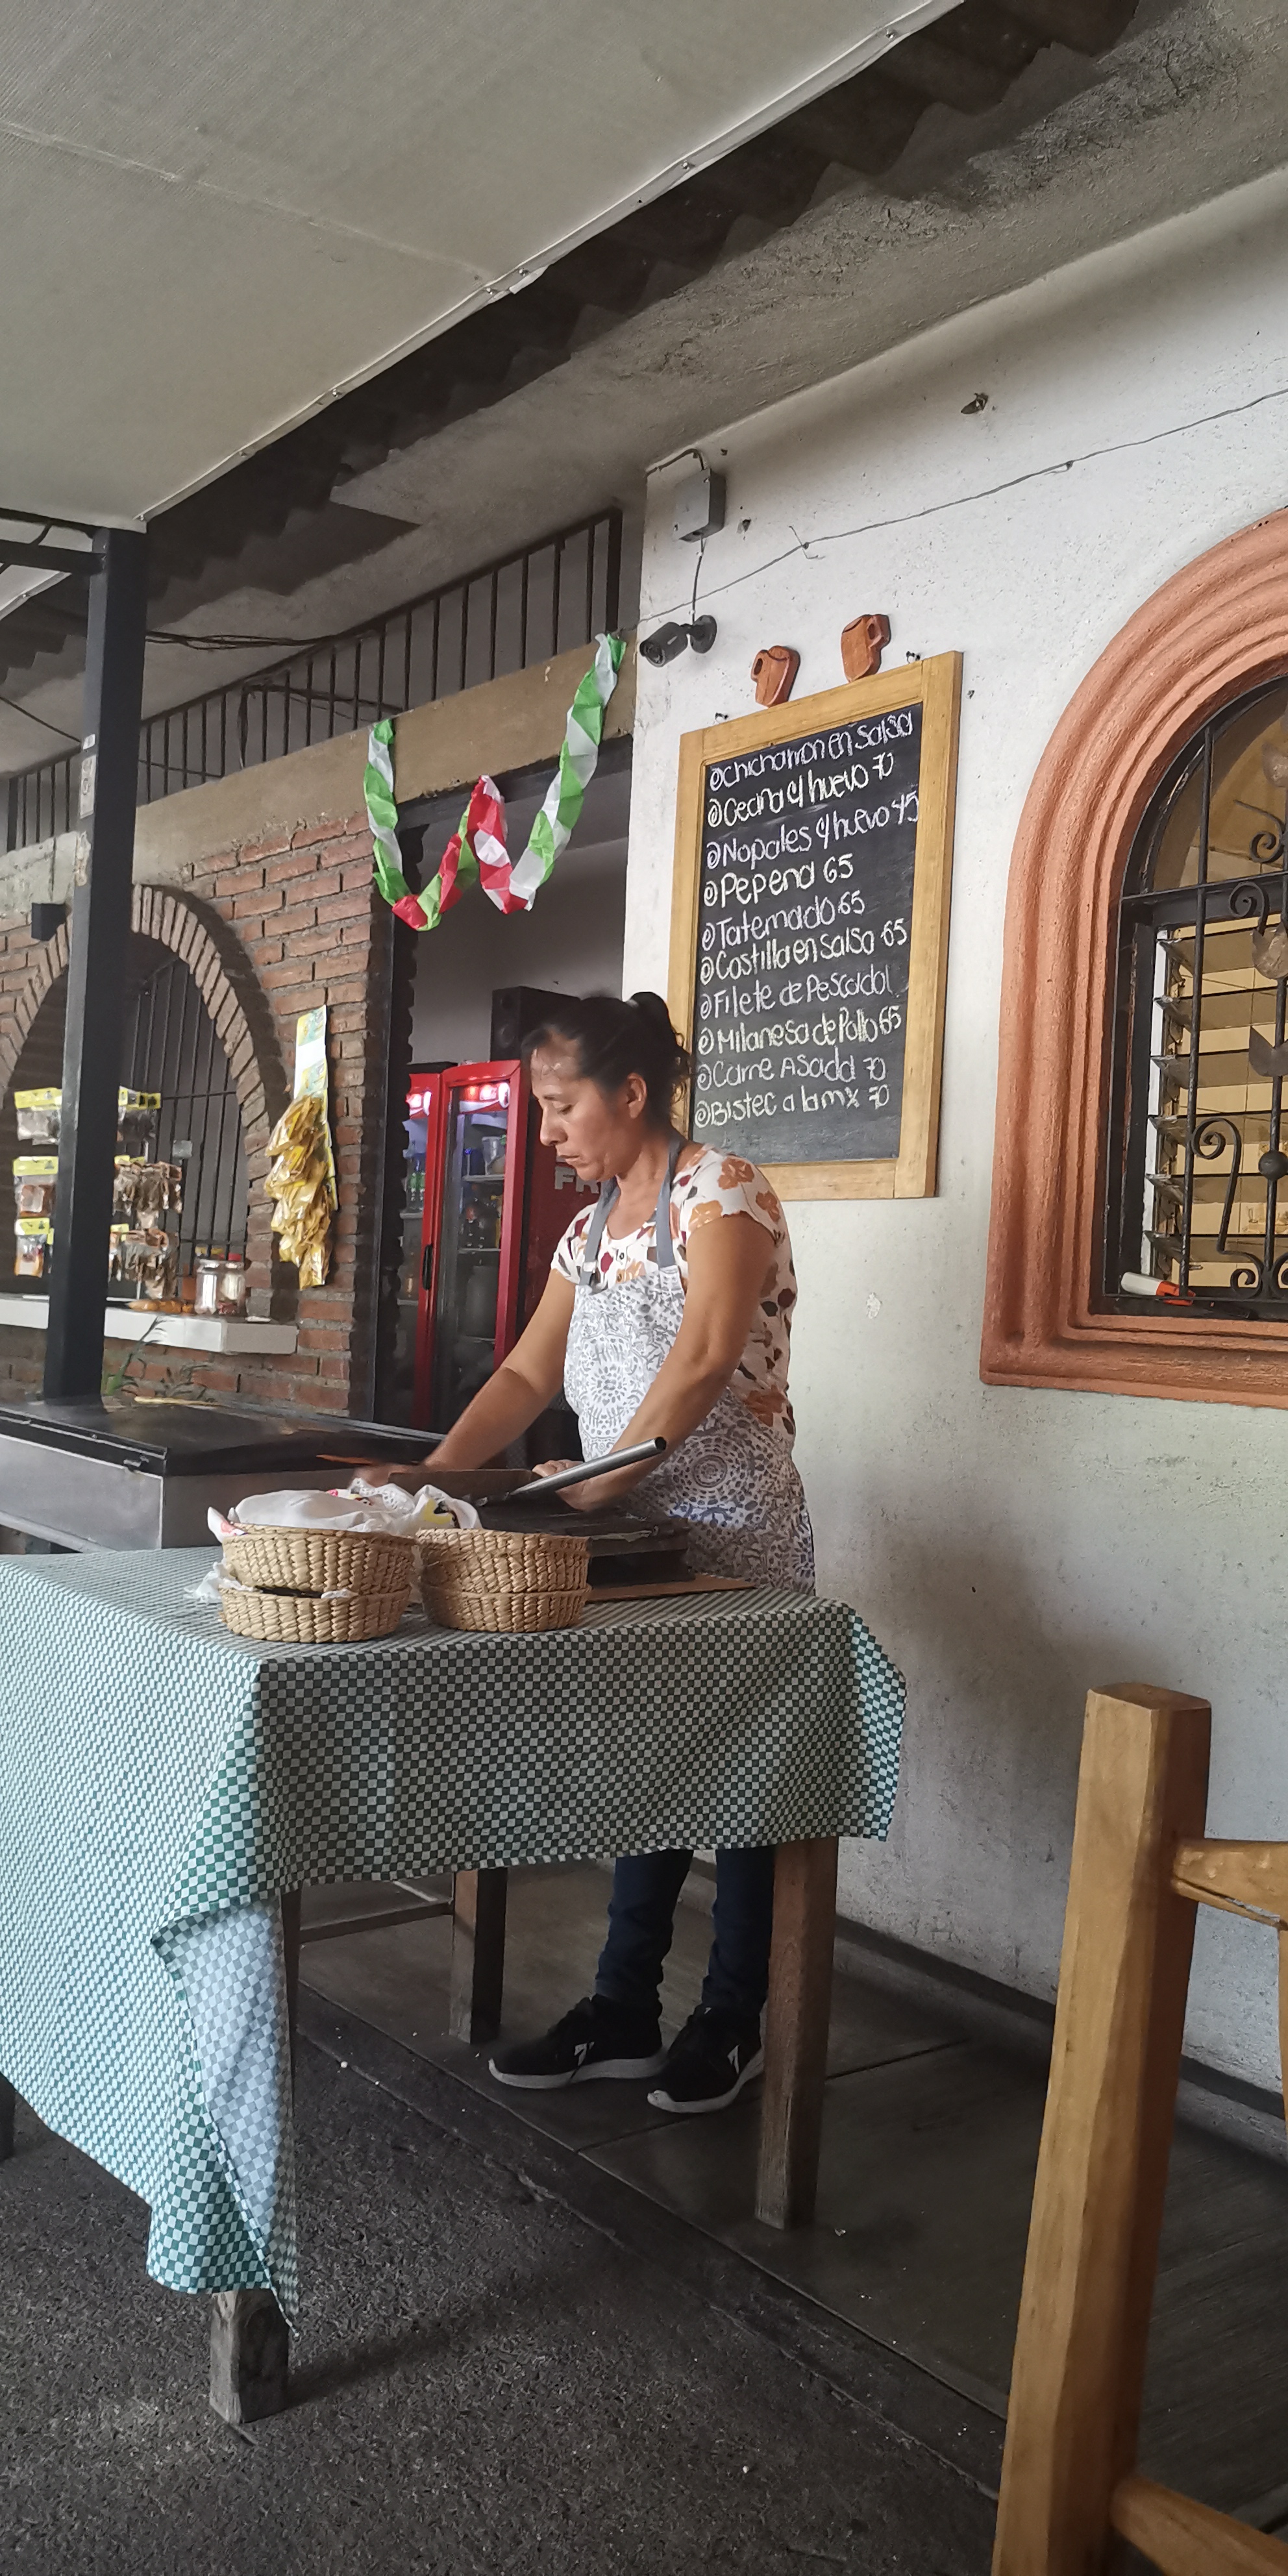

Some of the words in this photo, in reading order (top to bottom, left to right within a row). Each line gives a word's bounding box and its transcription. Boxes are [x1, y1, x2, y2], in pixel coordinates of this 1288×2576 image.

[828, 731, 854, 760] en
[808, 769, 869, 804] huevo
[723, 824, 812, 870] Nopales
[833, 810, 890, 841] huevo
[721, 861, 815, 908] Pepena
[823, 852, 854, 884] 65
[837, 890, 865, 915] 65
[716, 937, 789, 981] Costilla
[793, 936, 818, 966] en
[880, 918, 908, 947] 65
[713, 979, 776, 1019] Filete
[779, 979, 802, 1007] de
[717, 1019, 810, 1054] Milanesa
[811, 1010, 837, 1046] de
[838, 1006, 878, 1043] Pollo
[879, 1004, 902, 1035] 65
[713, 1056, 776, 1087] Carne
[863, 1056, 887, 1081] 70
[710, 1091, 778, 1127] Bistec
[782, 1098, 796, 1112] a
[869, 1084, 890, 1110] 70
